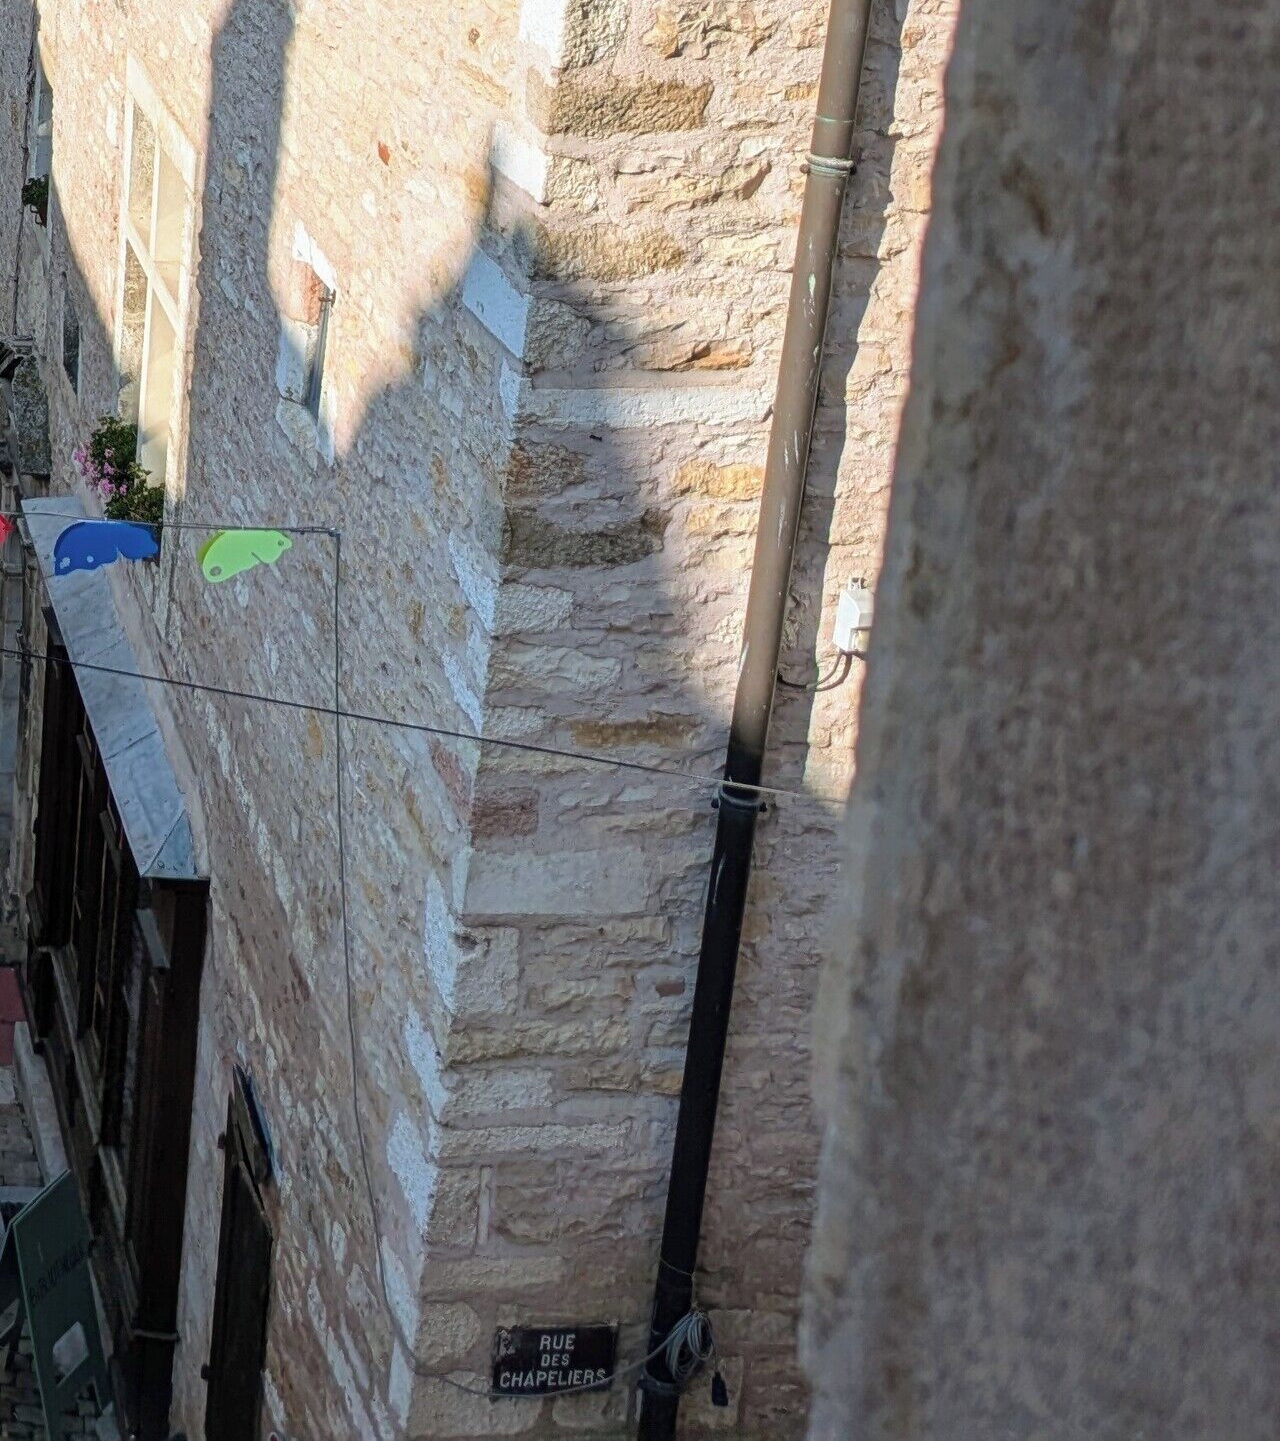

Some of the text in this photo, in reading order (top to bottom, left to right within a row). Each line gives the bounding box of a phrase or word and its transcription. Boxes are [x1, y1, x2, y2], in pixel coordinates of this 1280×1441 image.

[540, 1334, 576, 1350] RUE
[540, 1353, 570, 1367] DES
[500, 1369, 606, 1387] CHAPELIERS
